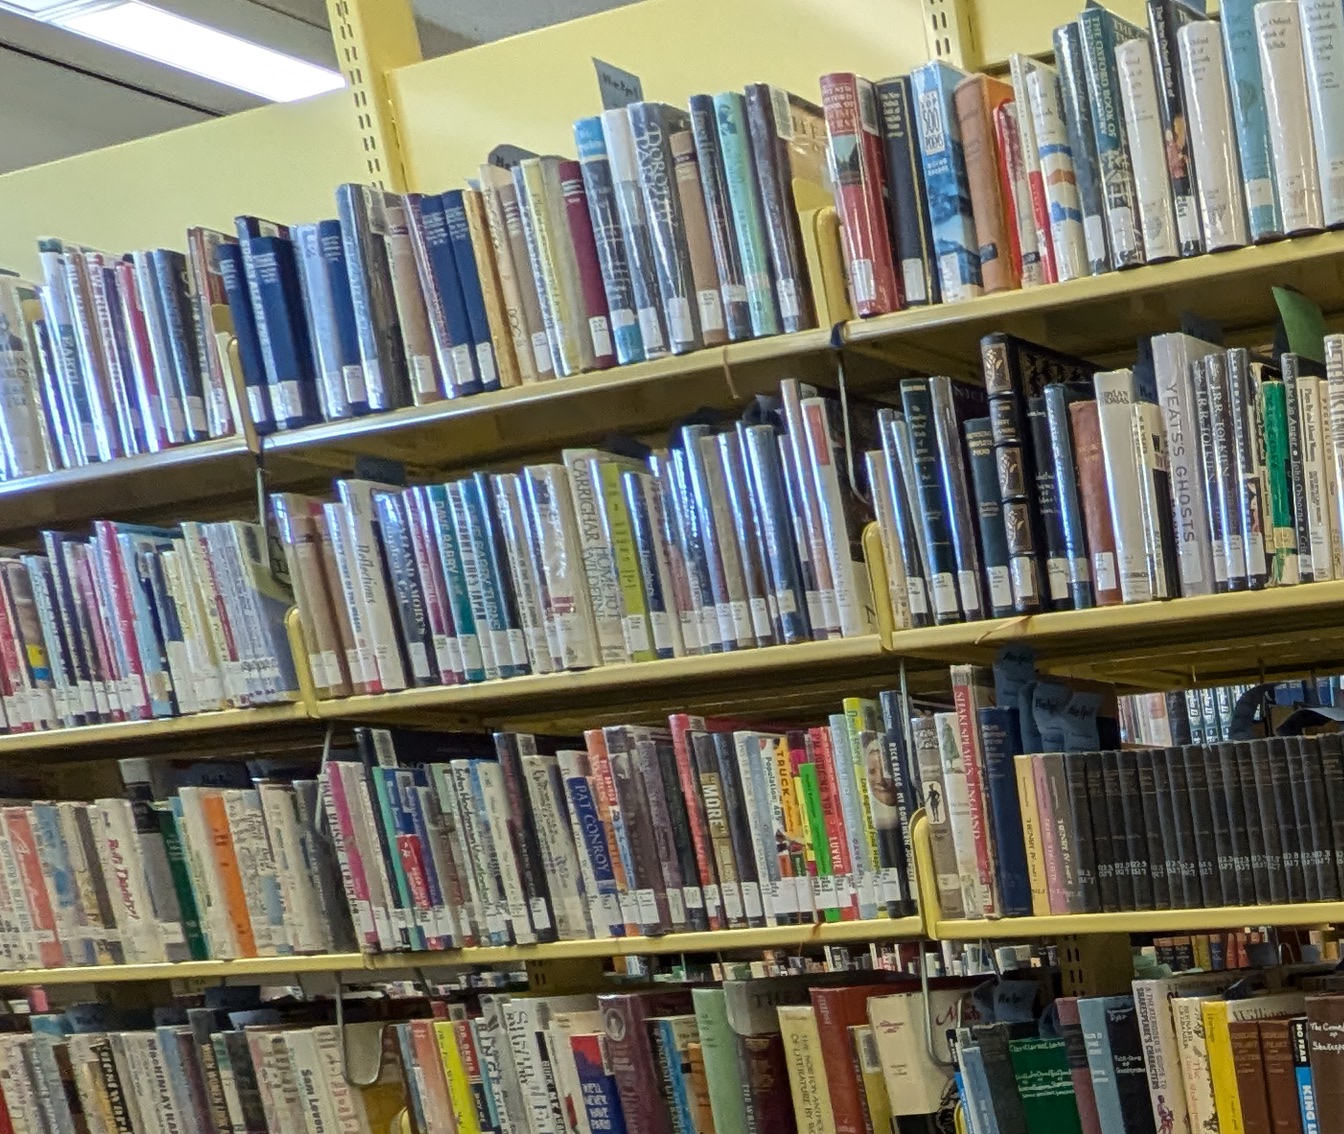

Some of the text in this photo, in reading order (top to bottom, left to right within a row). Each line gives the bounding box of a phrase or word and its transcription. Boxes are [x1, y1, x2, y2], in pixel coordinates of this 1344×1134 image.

[1163, 382, 1195, 543] YEATS'S GHOSTS
[1215, 419, 1230, 477] TOLKIEN
[571, 456, 601, 543] CARRIGHAR
[776, 751, 790, 796] TRUCK
[573, 785, 610, 873] PAT CONROY
[1309, 1023, 1322, 1032] The
[1301, 1084, 1314, 1119] KING
